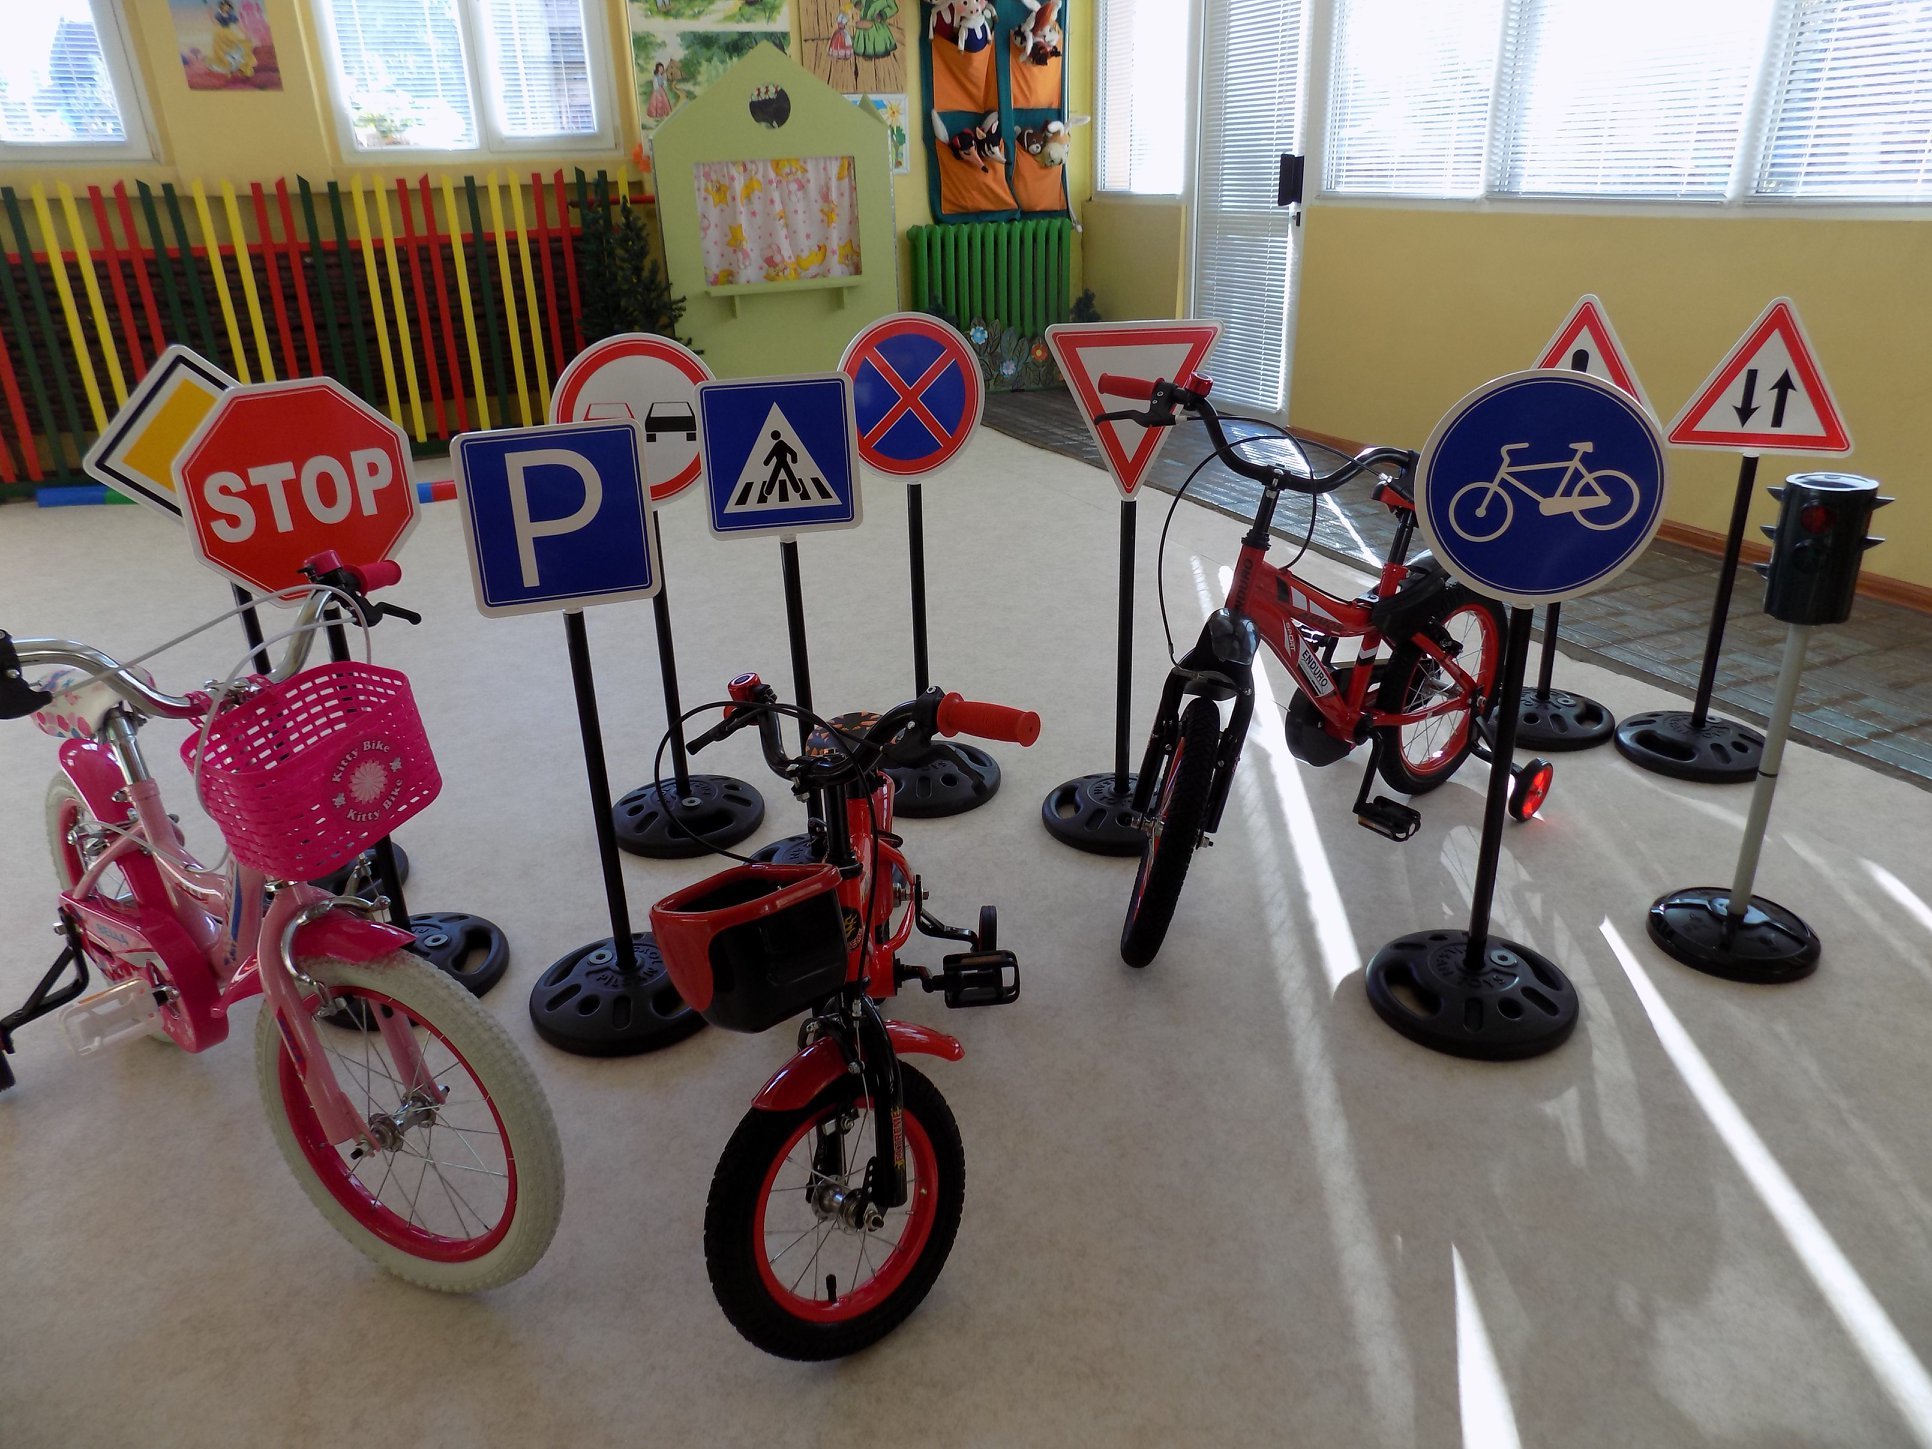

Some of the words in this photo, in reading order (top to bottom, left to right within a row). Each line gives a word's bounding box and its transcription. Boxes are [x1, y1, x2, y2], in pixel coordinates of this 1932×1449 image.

[204, 448, 393, 544] STOP
[505, 448, 603, 588] P
[1234, 559, 1253, 610] NDURO
[1285, 622, 1297, 652] SPORT
[1301, 650, 1328, 687] ENDURO
[331, 748, 359, 782] Kitty
[363, 740, 390, 753] Bike
[347, 808, 380, 822] Kitty
[383, 780, 403, 810] Bike
